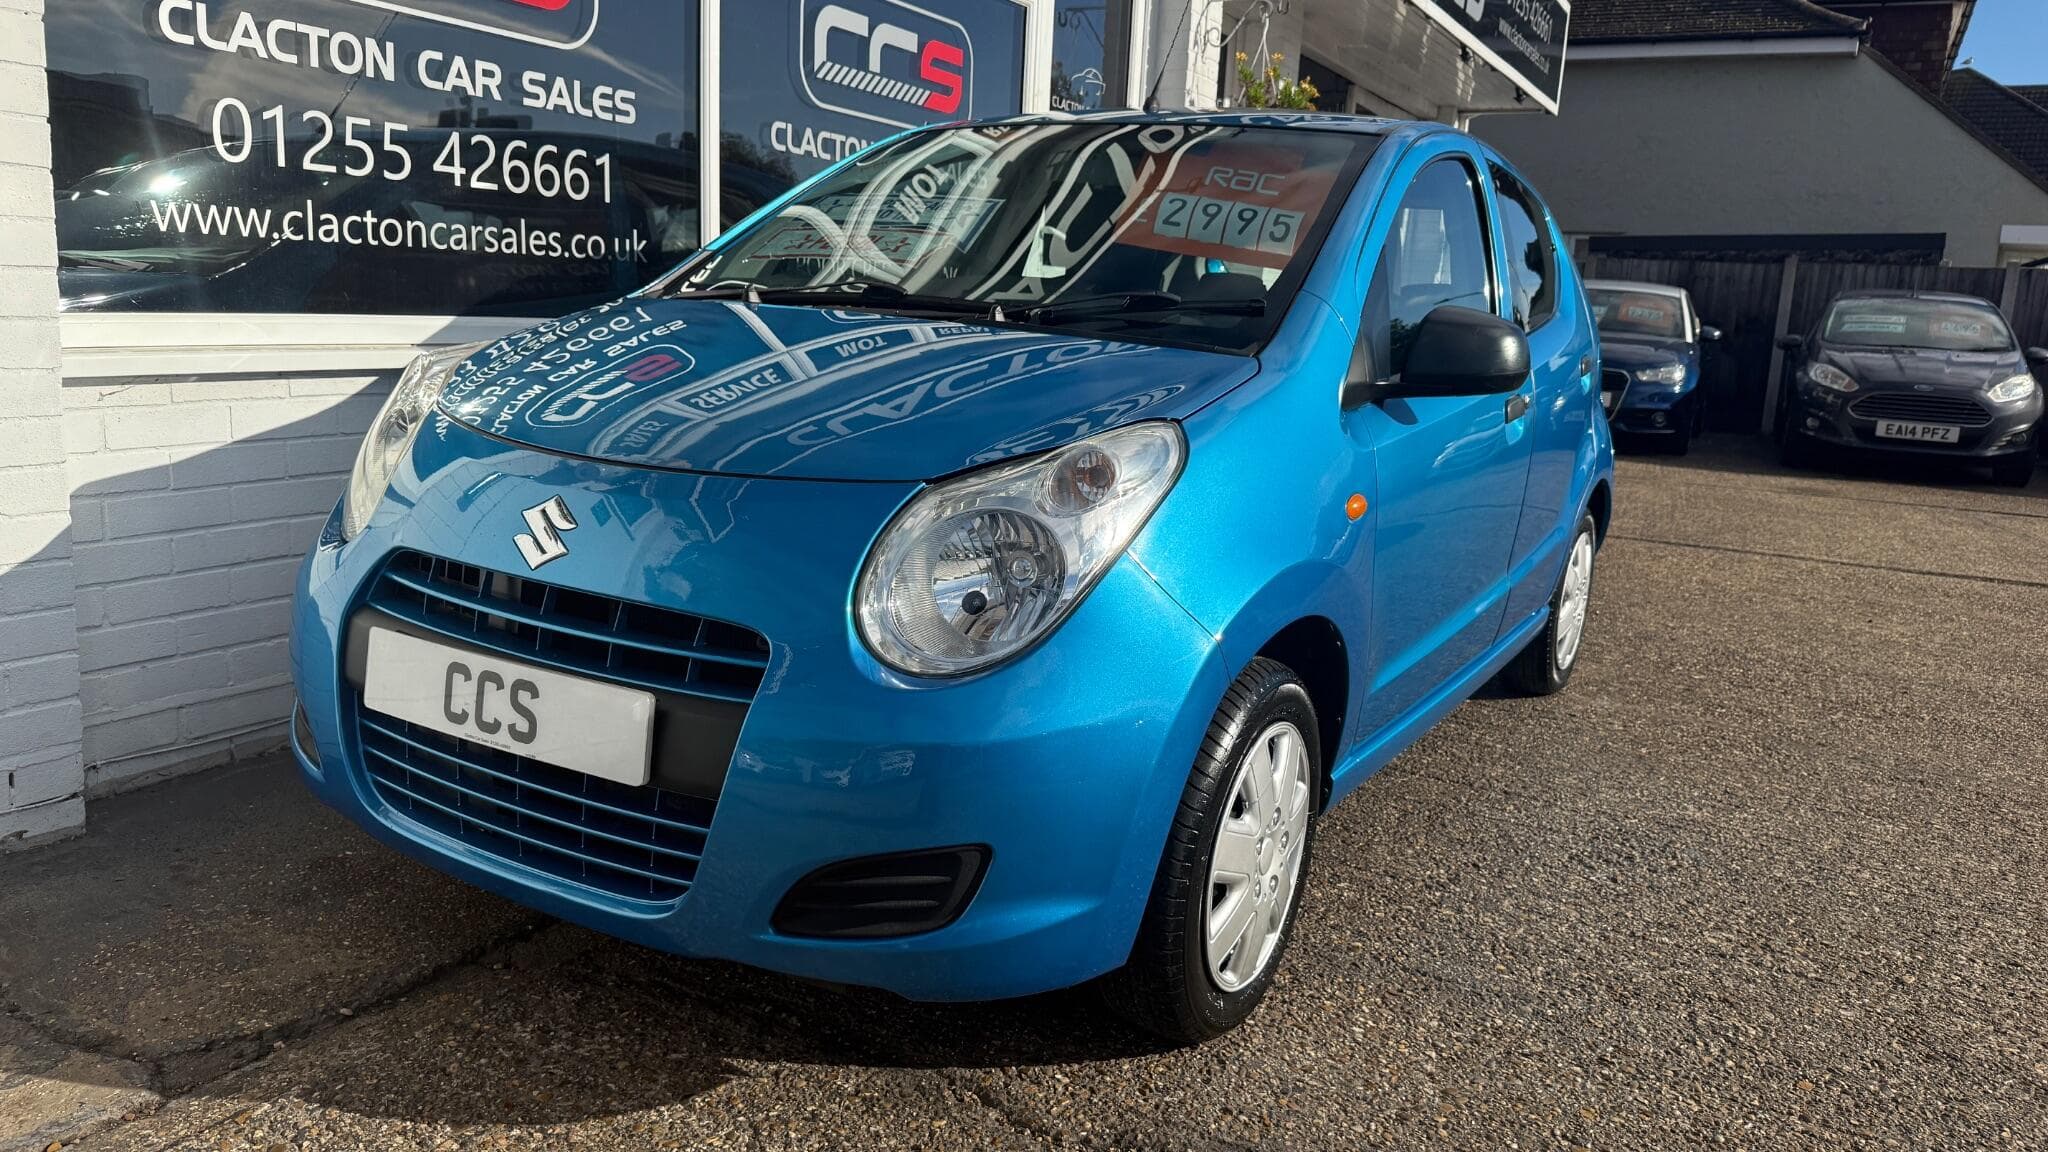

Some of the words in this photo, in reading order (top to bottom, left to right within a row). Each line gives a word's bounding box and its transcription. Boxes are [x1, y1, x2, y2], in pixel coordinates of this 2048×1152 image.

[158, 0, 395, 82] CLACTON
[417, 49, 502, 101] CAR
[521, 70, 636, 125] SALES
[814, 4, 964, 115] CCS
[212, 97, 412, 181] 01255
[432, 131, 612, 204] 426661
[150, 199, 648, 263] www.clactoncarsales.co.uk
[1161, 197, 1296, 244] 2995
[1885, 423, 1917, 437] EA14
[1921, 426, 1951, 440] PFZ
[444, 661, 540, 745] CCS
